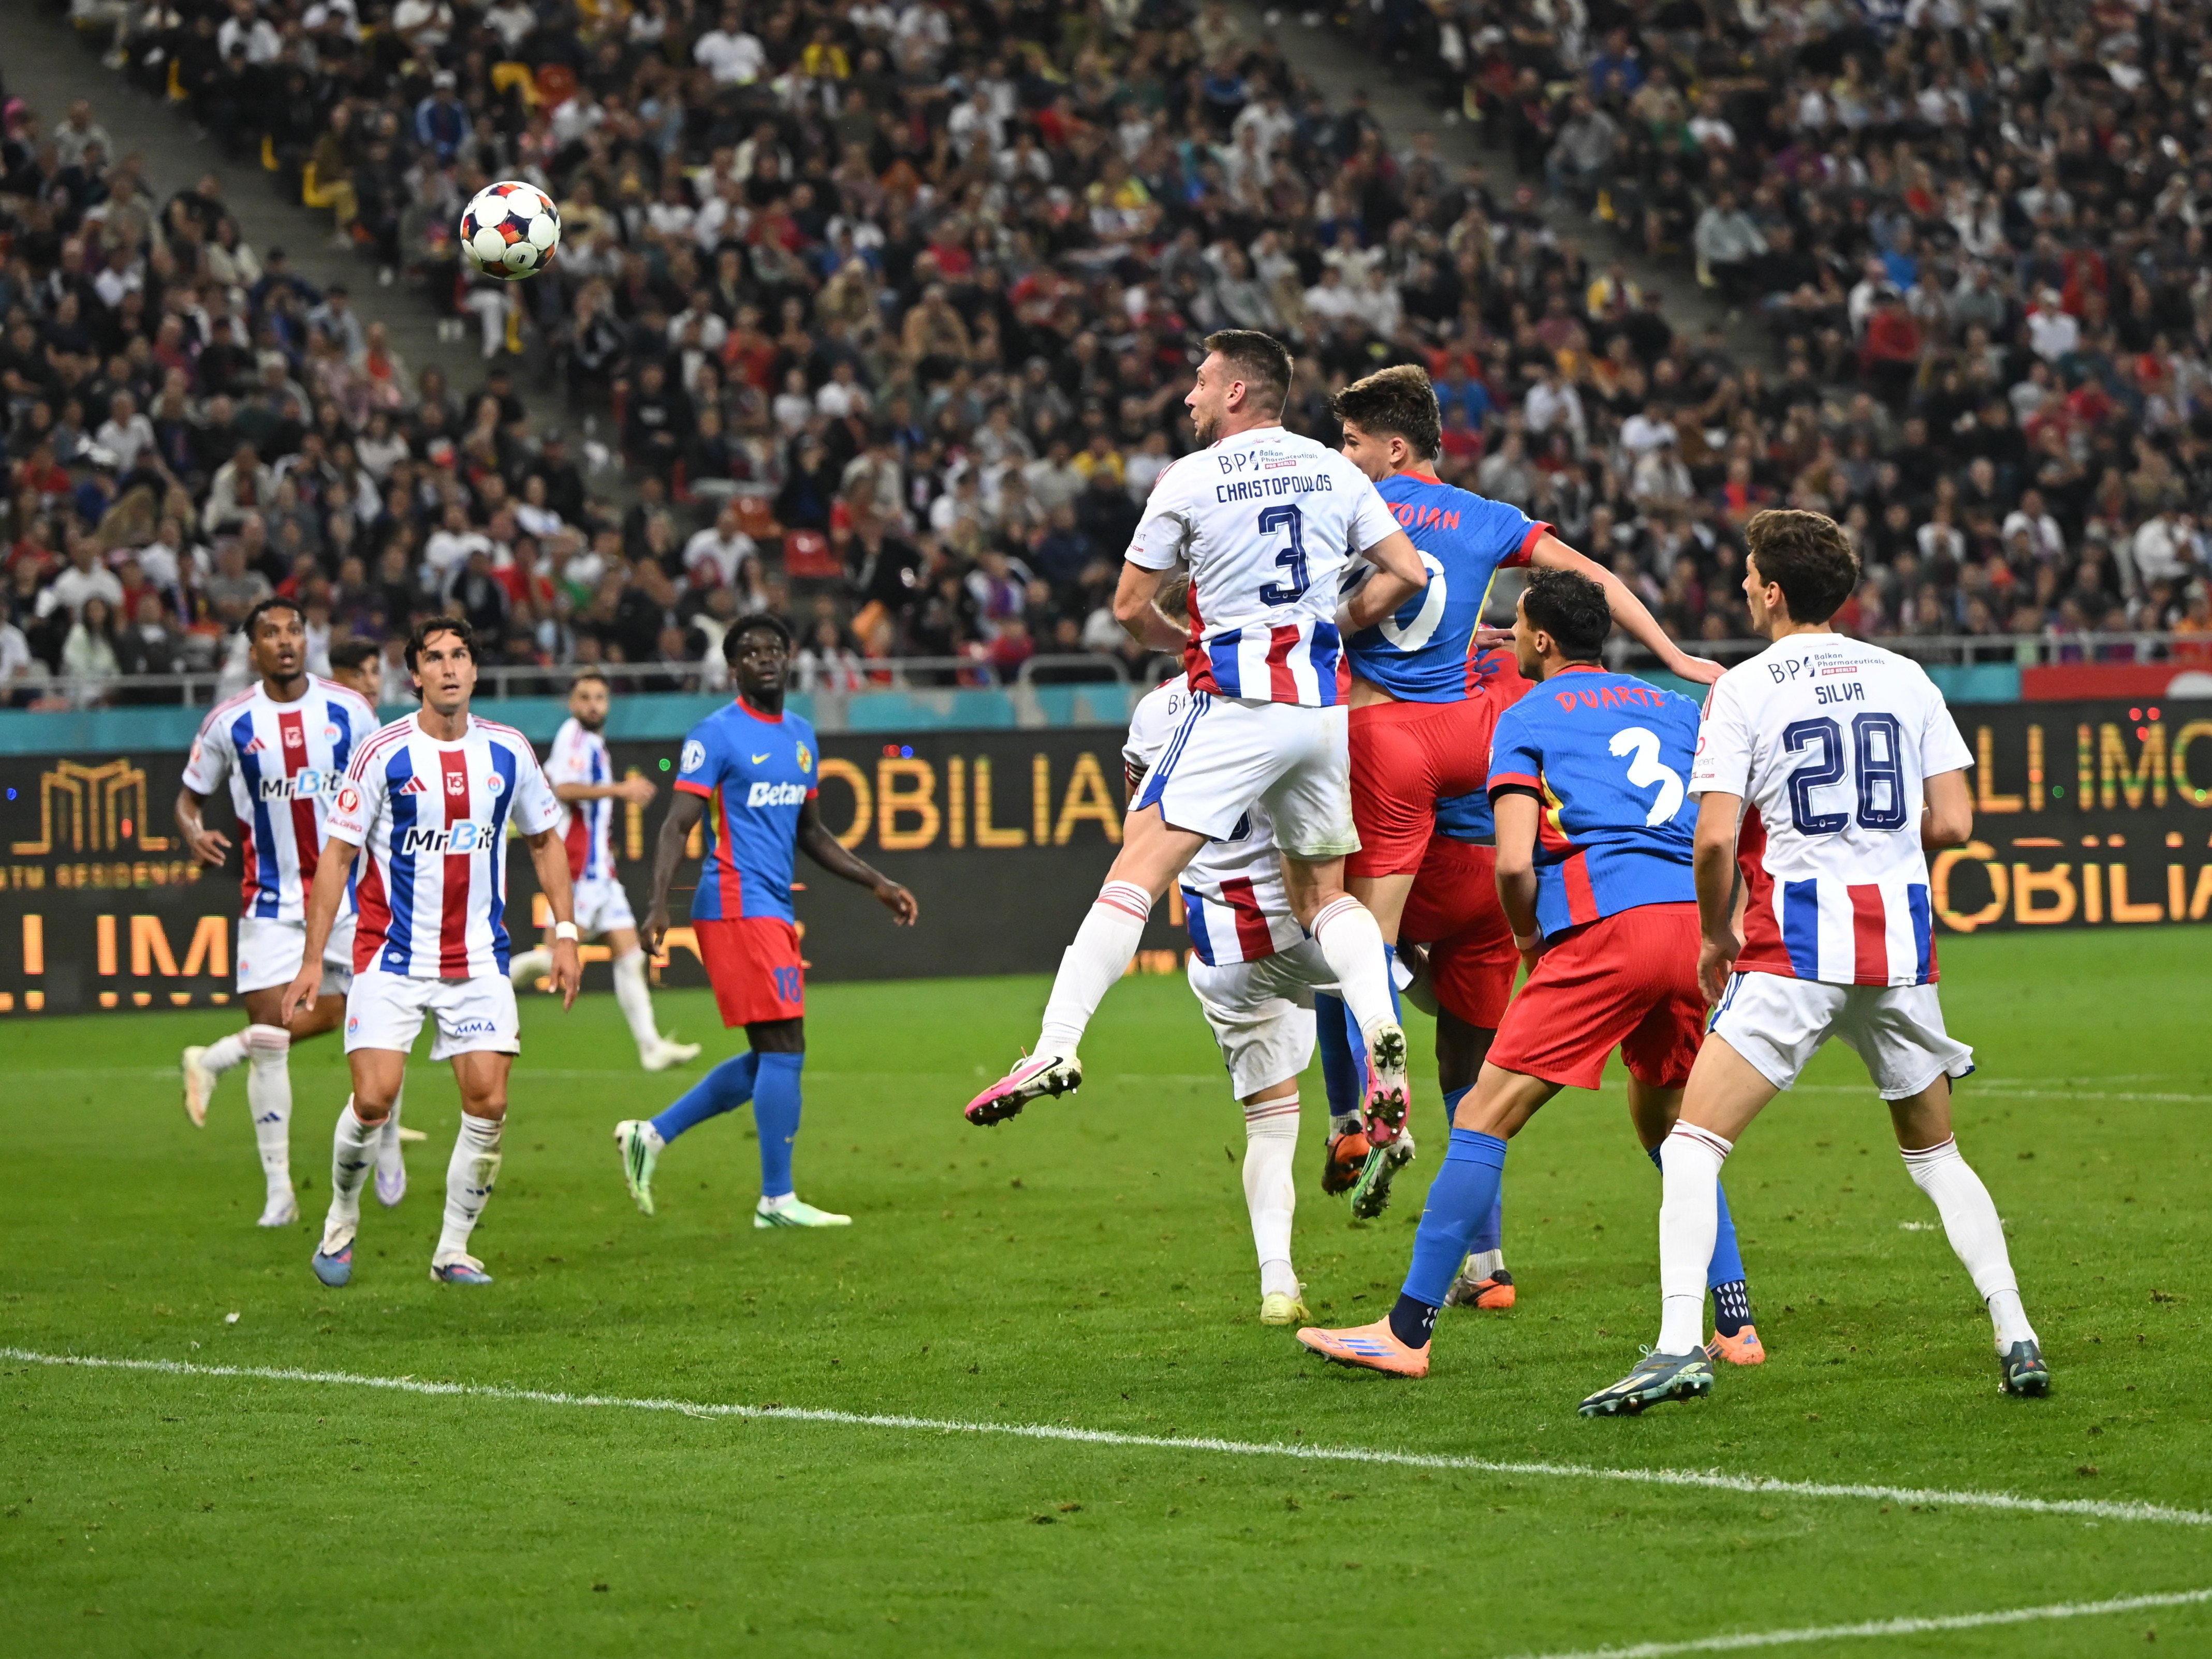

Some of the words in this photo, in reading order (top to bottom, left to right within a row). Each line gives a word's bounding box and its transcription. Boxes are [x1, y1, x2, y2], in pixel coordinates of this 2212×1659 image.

[1261, 453, 1319, 463] Pharmaceuticals
[1217, 474, 1332, 503] CHRISTOPOULOS
[1258, 504, 1310, 608] 3
[1818, 658, 1885, 667] Pharmaceuticals
[1555, 686, 1666, 713] DUARTE
[1815, 682, 1865, 704] SILVA
[1608, 727, 1684, 827] 3
[1782, 712, 1909, 838] 28
[405, 822, 493, 851] MrBit
[773, 966, 802, 1003] 18
[455, 1021, 495, 1036] MMA
